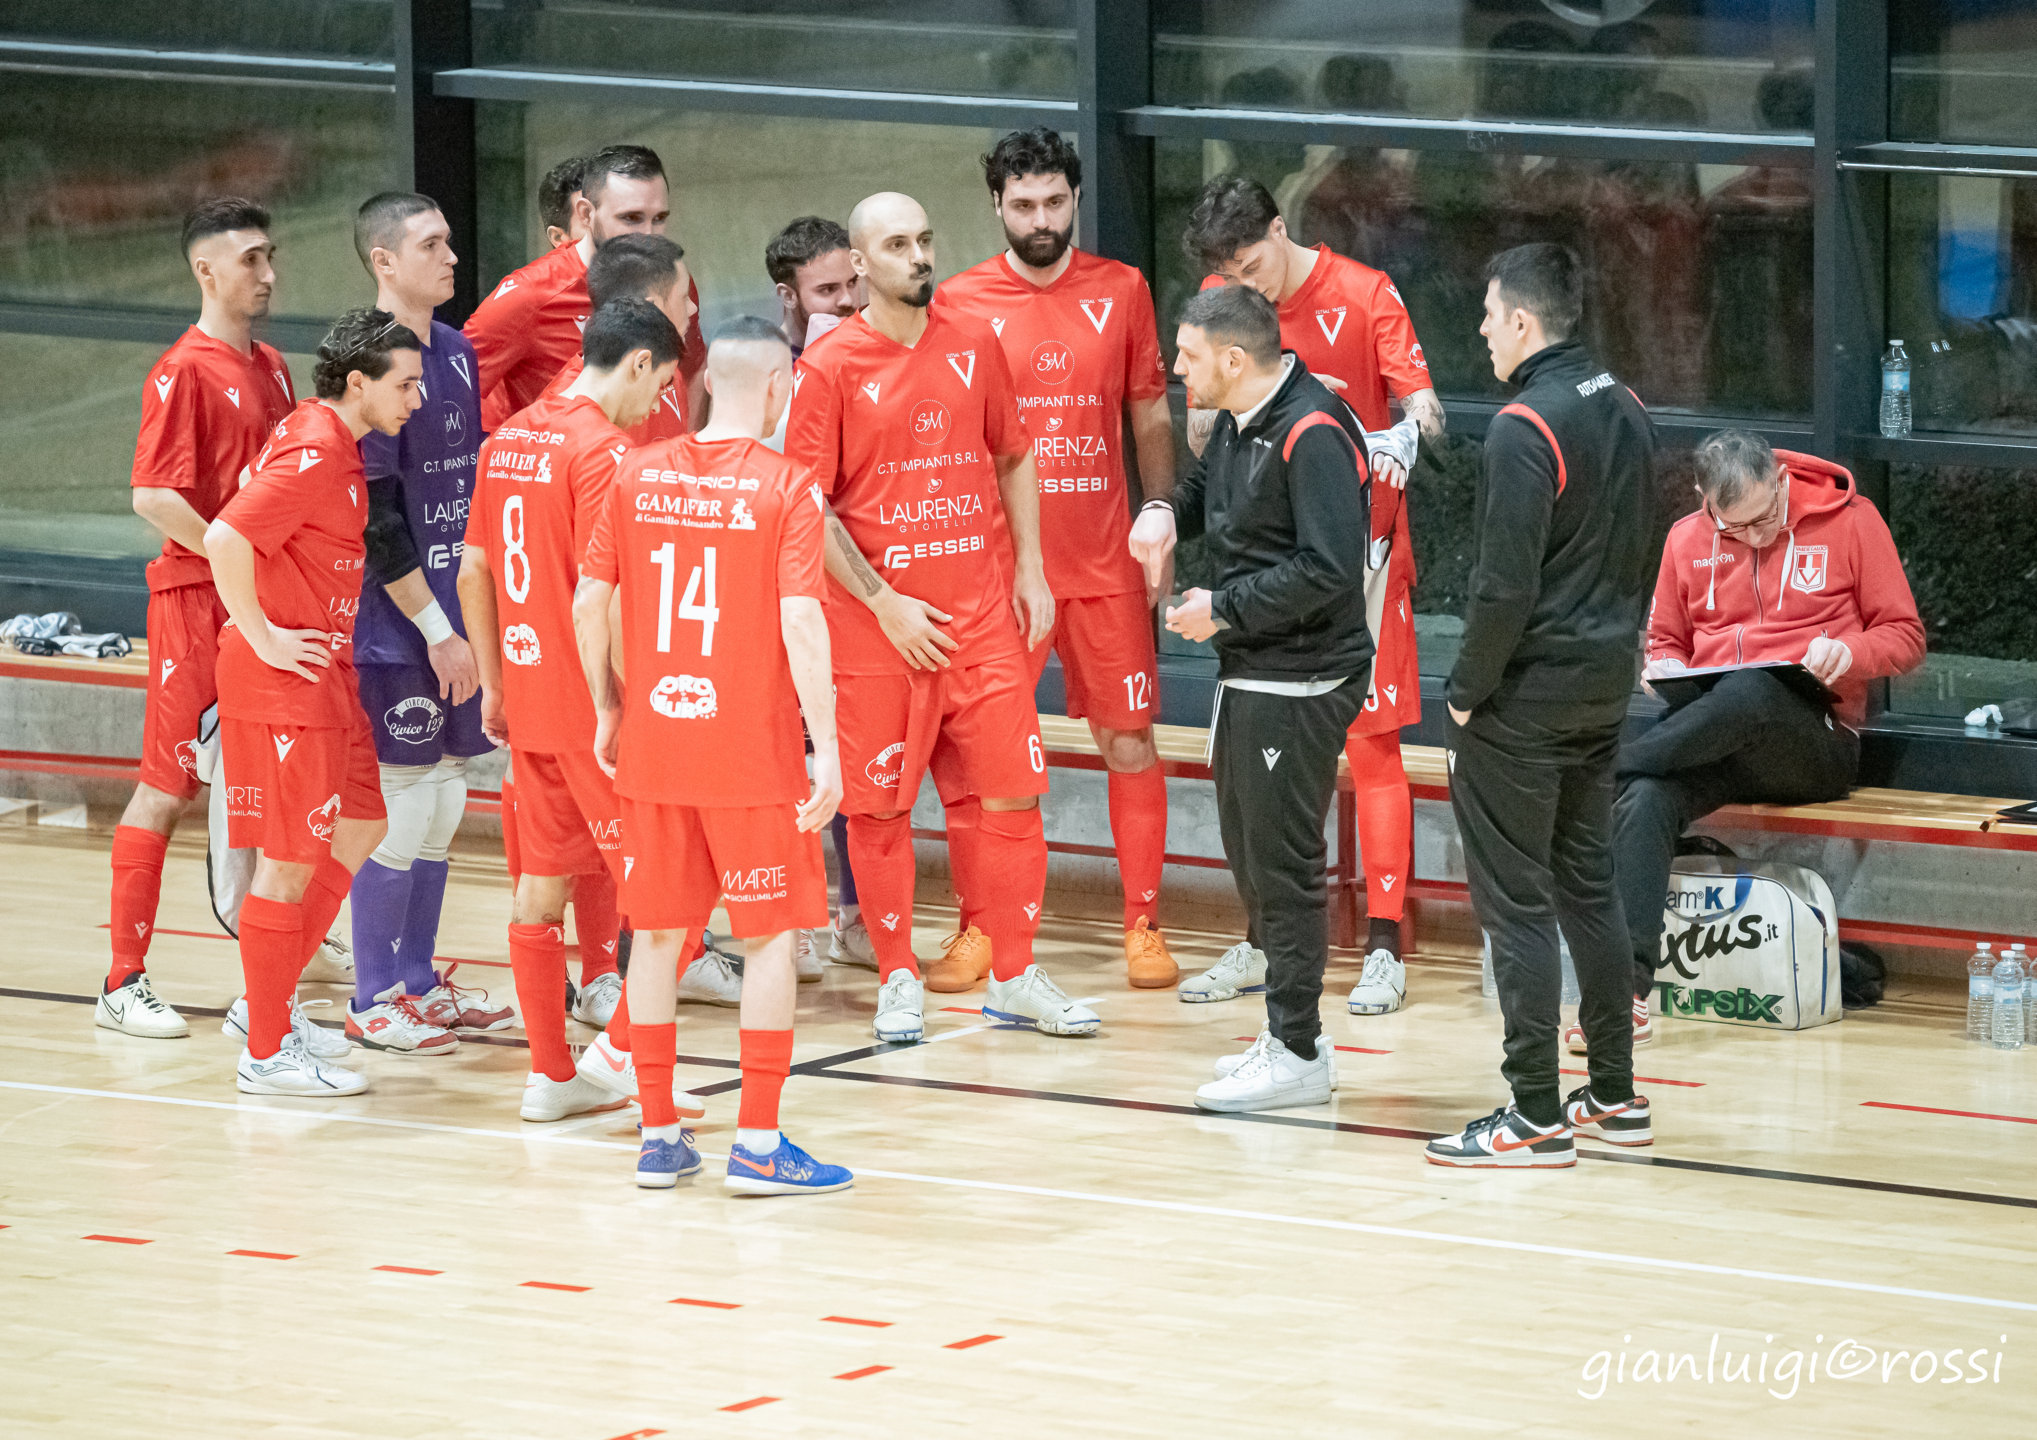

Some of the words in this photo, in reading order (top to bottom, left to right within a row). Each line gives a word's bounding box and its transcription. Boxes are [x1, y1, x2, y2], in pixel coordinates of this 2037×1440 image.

[423, 461, 441, 473] C.T.
[878, 462, 898, 475] C.T.
[901, 454, 952, 473] IMPIANTI
[635, 492, 722, 517] GAMIFER
[879, 493, 983, 525] LAURENZA
[503, 494, 531, 604] 8
[914, 535, 985, 558] ESSEBI
[650, 542, 720, 656] 14
[1123, 671, 1149, 711] 12
[389, 722, 423, 736] Civico
[1028, 734, 1045, 774] 6
[226, 785, 263, 808] ARTE
[722, 864, 787, 891] MARTE
